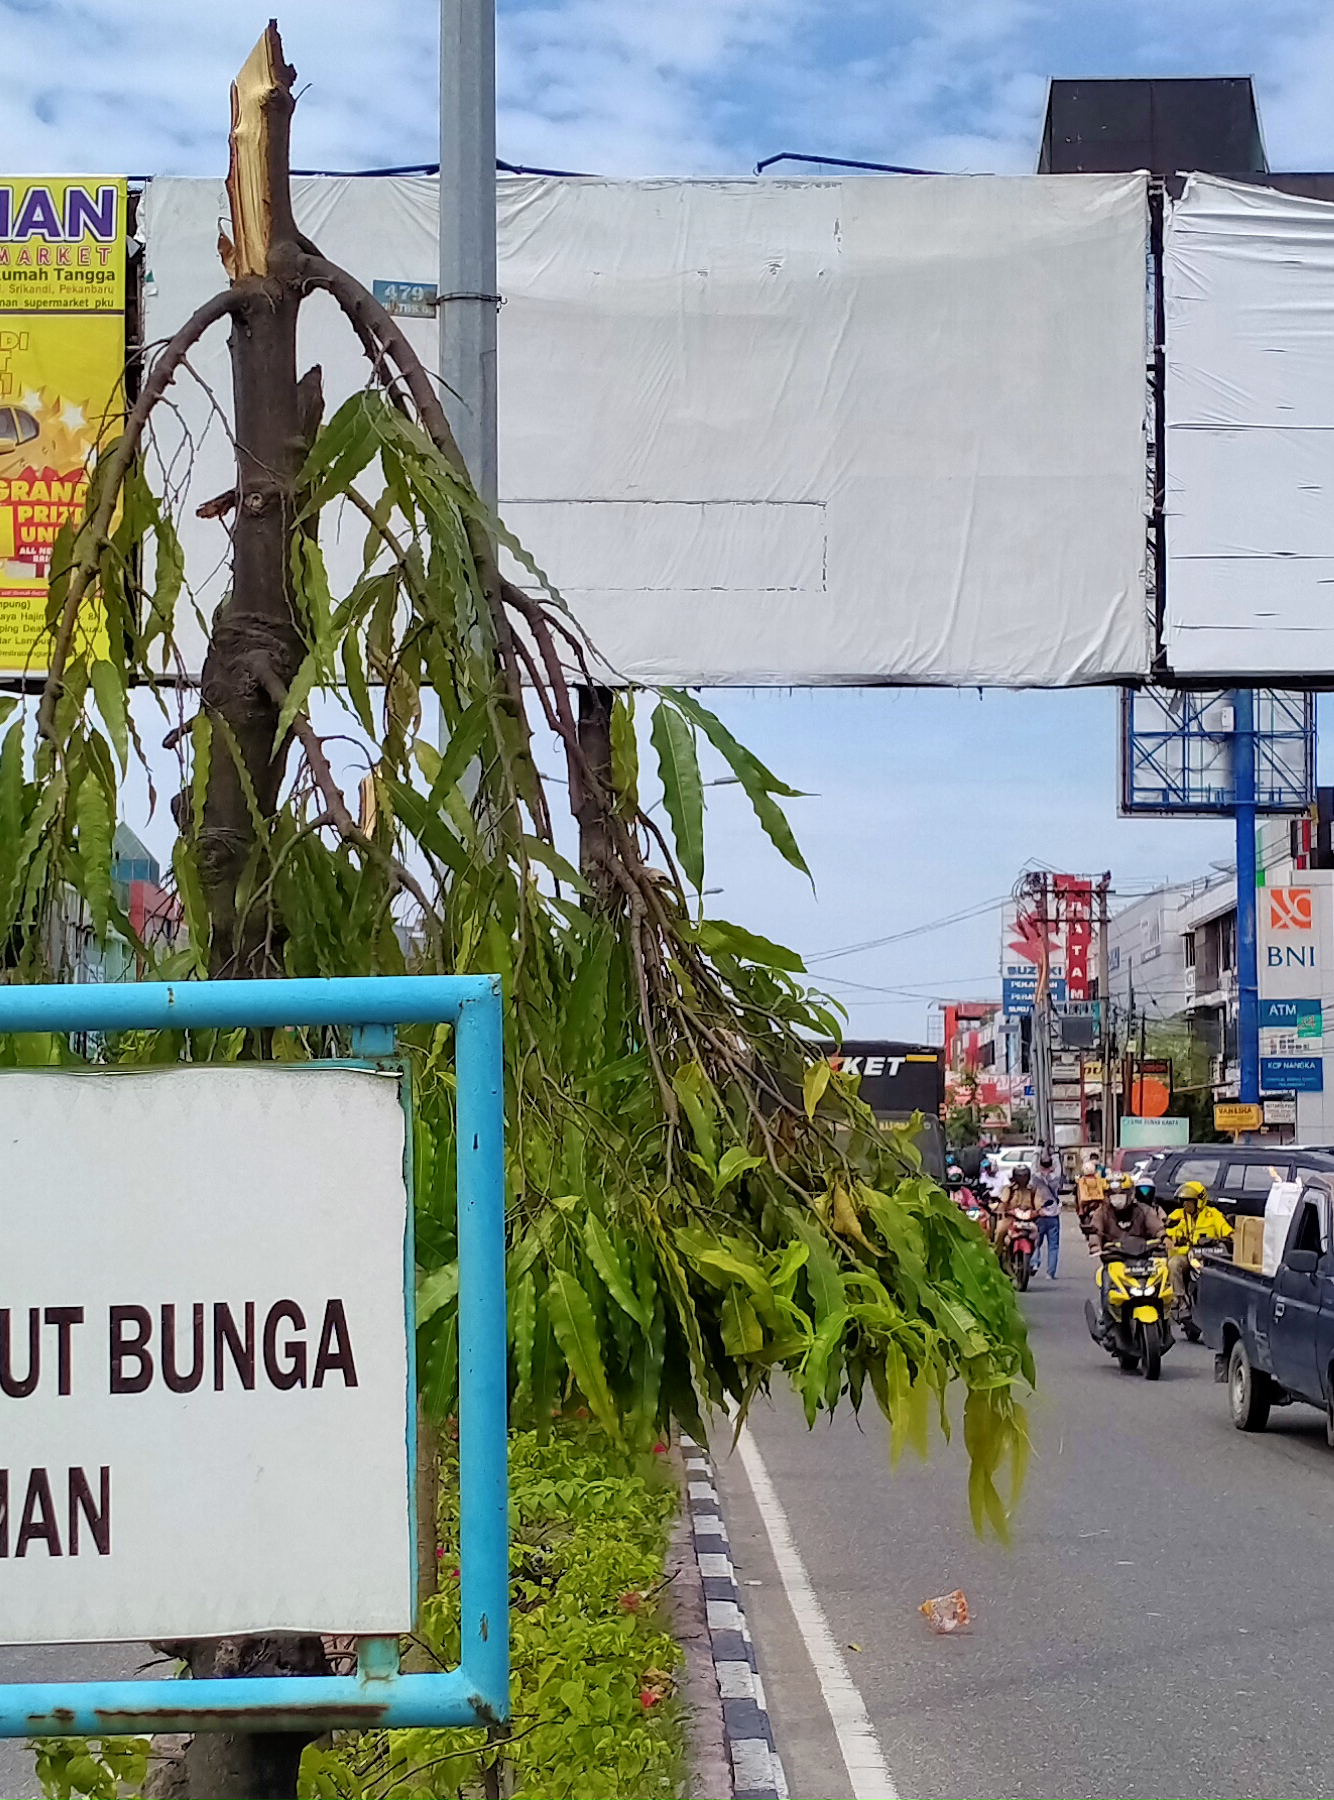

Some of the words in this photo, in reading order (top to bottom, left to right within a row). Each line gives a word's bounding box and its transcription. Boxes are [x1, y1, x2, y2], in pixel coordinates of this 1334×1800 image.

[54, 268, 115, 284] Tangga
[9, 284, 55, 296] Srikandi,
[59, 284, 115, 295] Pekanbaru
[384, 284, 425, 301] 479
[1268, 946, 1315, 967] BNI
[1007, 966, 1062, 976] SUZKI
[1269, 1004, 1297, 1016] ATM
[107, 1299, 358, 1394] BUNGA
